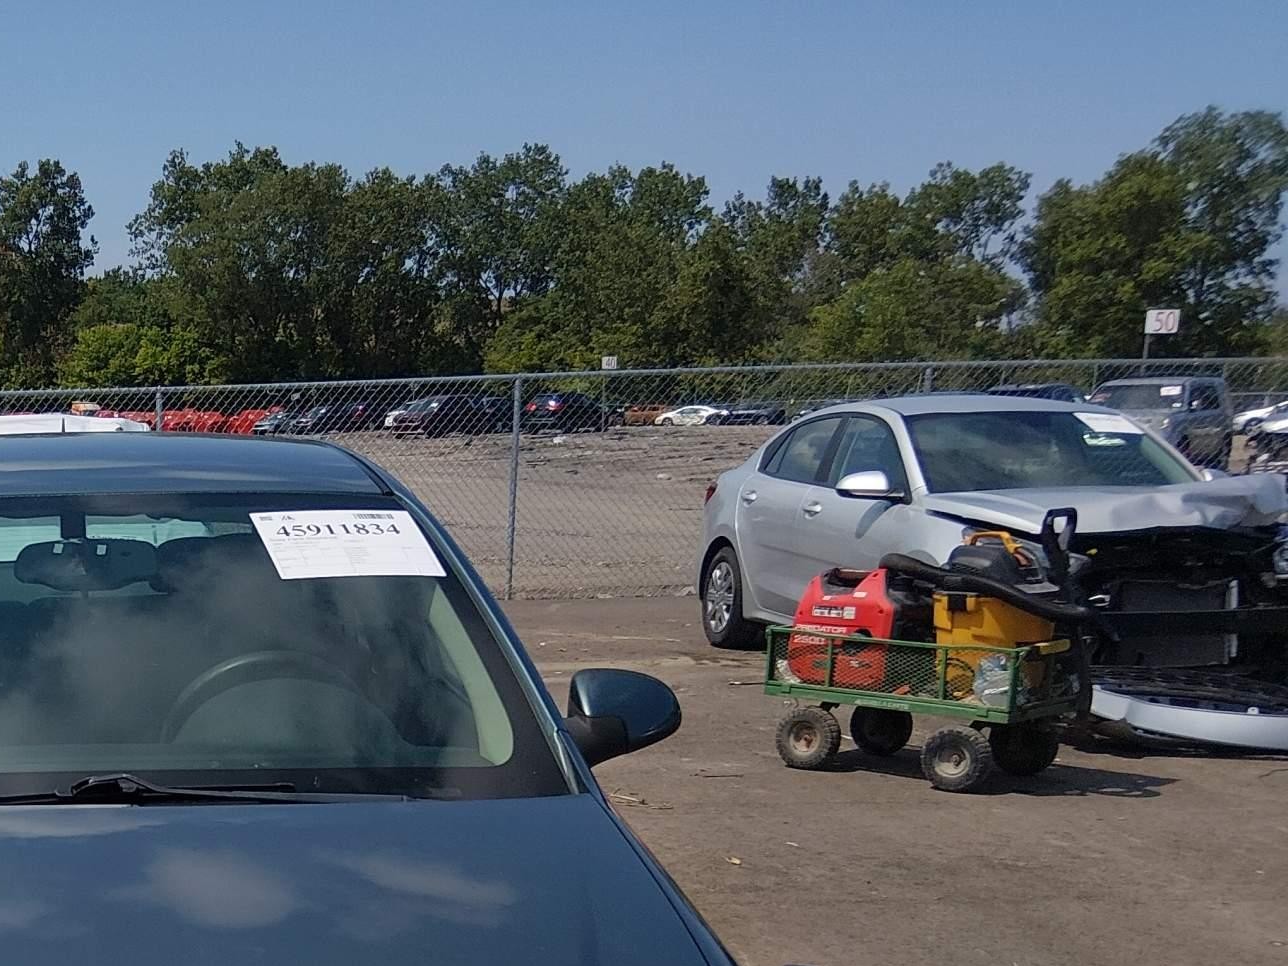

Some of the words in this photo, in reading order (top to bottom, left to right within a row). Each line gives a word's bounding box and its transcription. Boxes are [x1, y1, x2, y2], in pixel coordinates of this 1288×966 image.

[1152, 311, 1176, 332] 50
[276, 523, 401, 537] 45911834
[795, 624, 848, 634] PREDATOR
